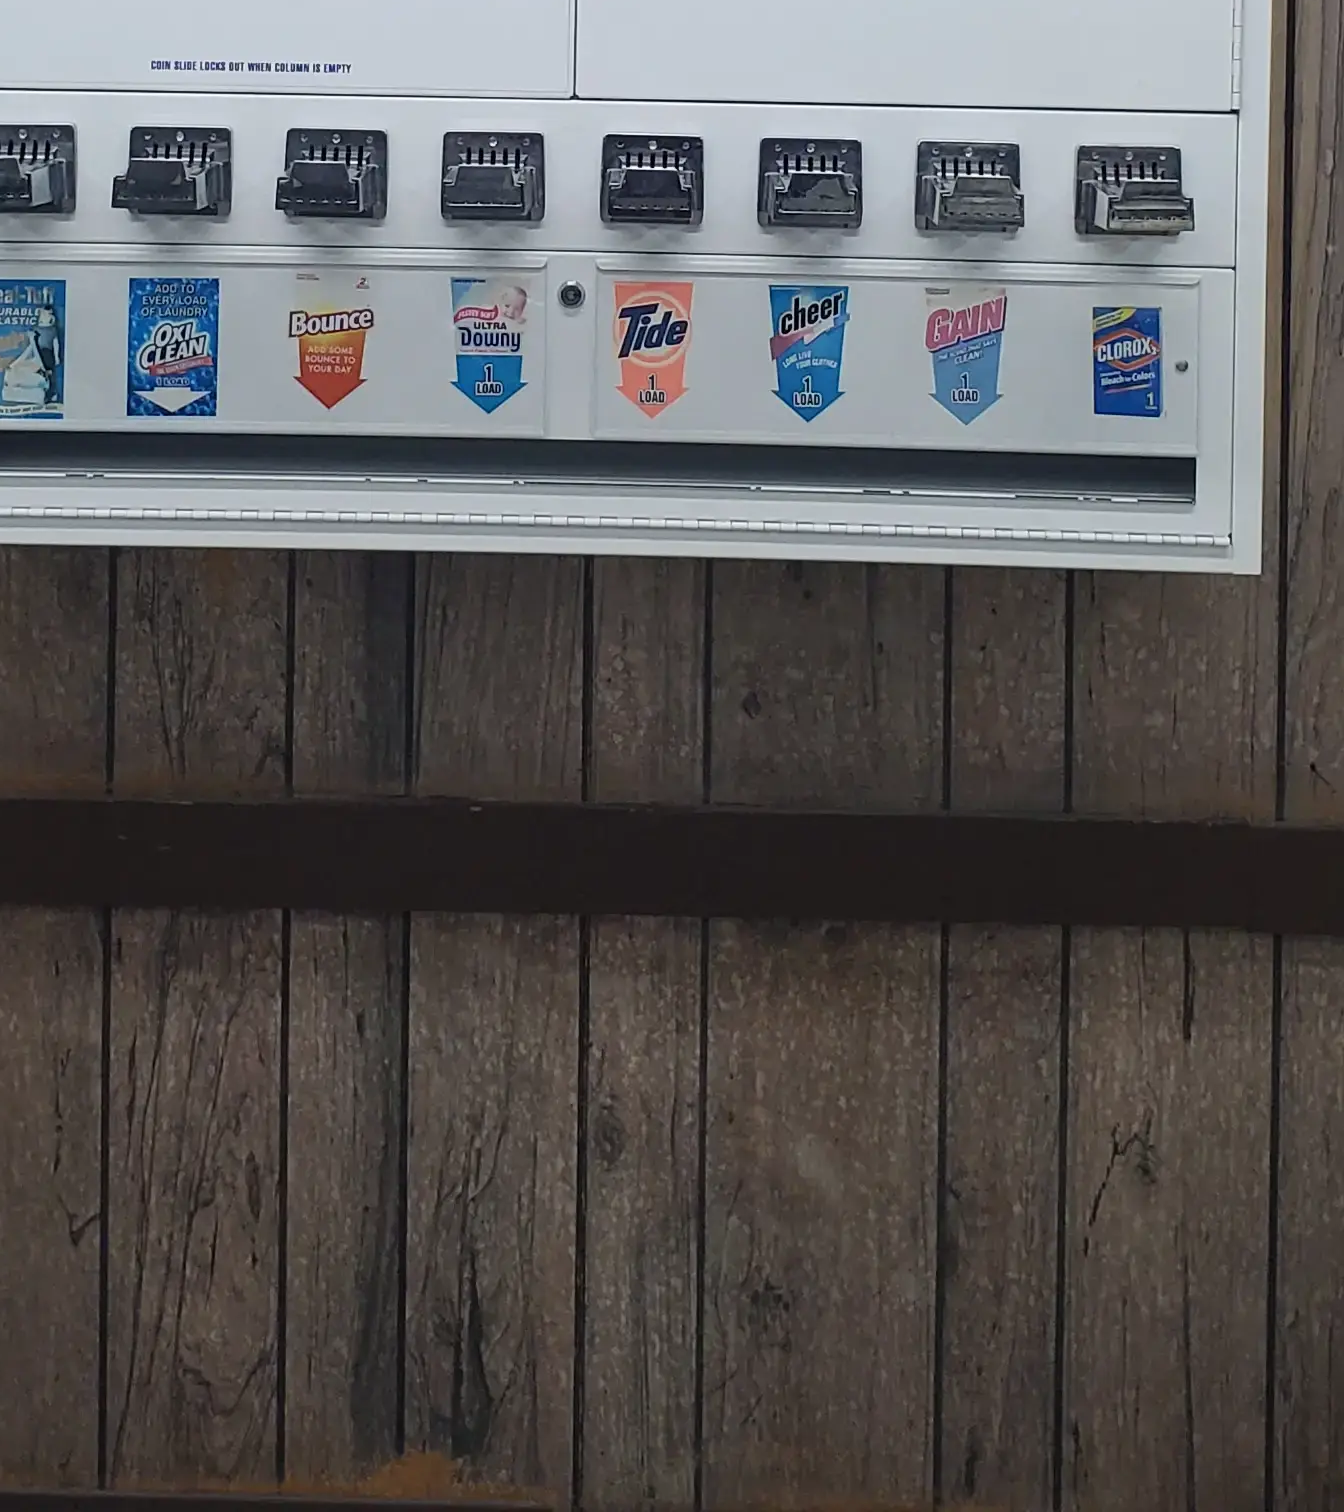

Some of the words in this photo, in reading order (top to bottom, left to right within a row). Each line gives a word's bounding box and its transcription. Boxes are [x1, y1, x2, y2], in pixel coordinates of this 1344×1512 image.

[151, 60, 171, 70] COIN
[174, 60, 197, 71] SLIDE
[200, 61, 225, 71] LOCKS
[229, 62, 244, 71] OUT
[248, 62, 271, 72] WHEN
[275, 62, 309, 72] COLUMN
[313, 63, 320, 73] IS
[324, 64, 351, 73] EMPTY
[155, 284, 176, 293] ADD
[181, 284, 194, 293] TO
[142, 296, 175, 305] EVERY
[179, 296, 207, 305] LOAD
[141, 308, 156, 316] OF
[159, 308, 208, 317] LAUNDRY
[780, 291, 844, 335] cheer
[290, 309, 373, 337] Bounce
[474, 322, 507, 330] ULTRA
[925, 296, 1007, 352] GAIN
[154, 322, 193, 348] OXI
[618, 303, 688, 358] Tide
[458, 327, 521, 352] Downy
[140, 335, 206, 370] CLEAN
[308, 346, 326, 354] ADD
[329, 346, 353, 355] SOME
[305, 355, 340, 363] BOUNCE
[344, 356, 356, 364] TO
[309, 365, 332, 373] YOUR
[335, 365, 352, 373] DAY
[485, 364, 493, 382] 1
[649, 374, 655, 390] 1
[803, 375, 811, 393] 1
[961, 372, 968, 389] 1
[477, 383, 501, 394] LOAD
[639, 391, 665, 403] LOAD
[795, 393, 821, 406] LOAD
[952, 390, 979, 402] LOAD
